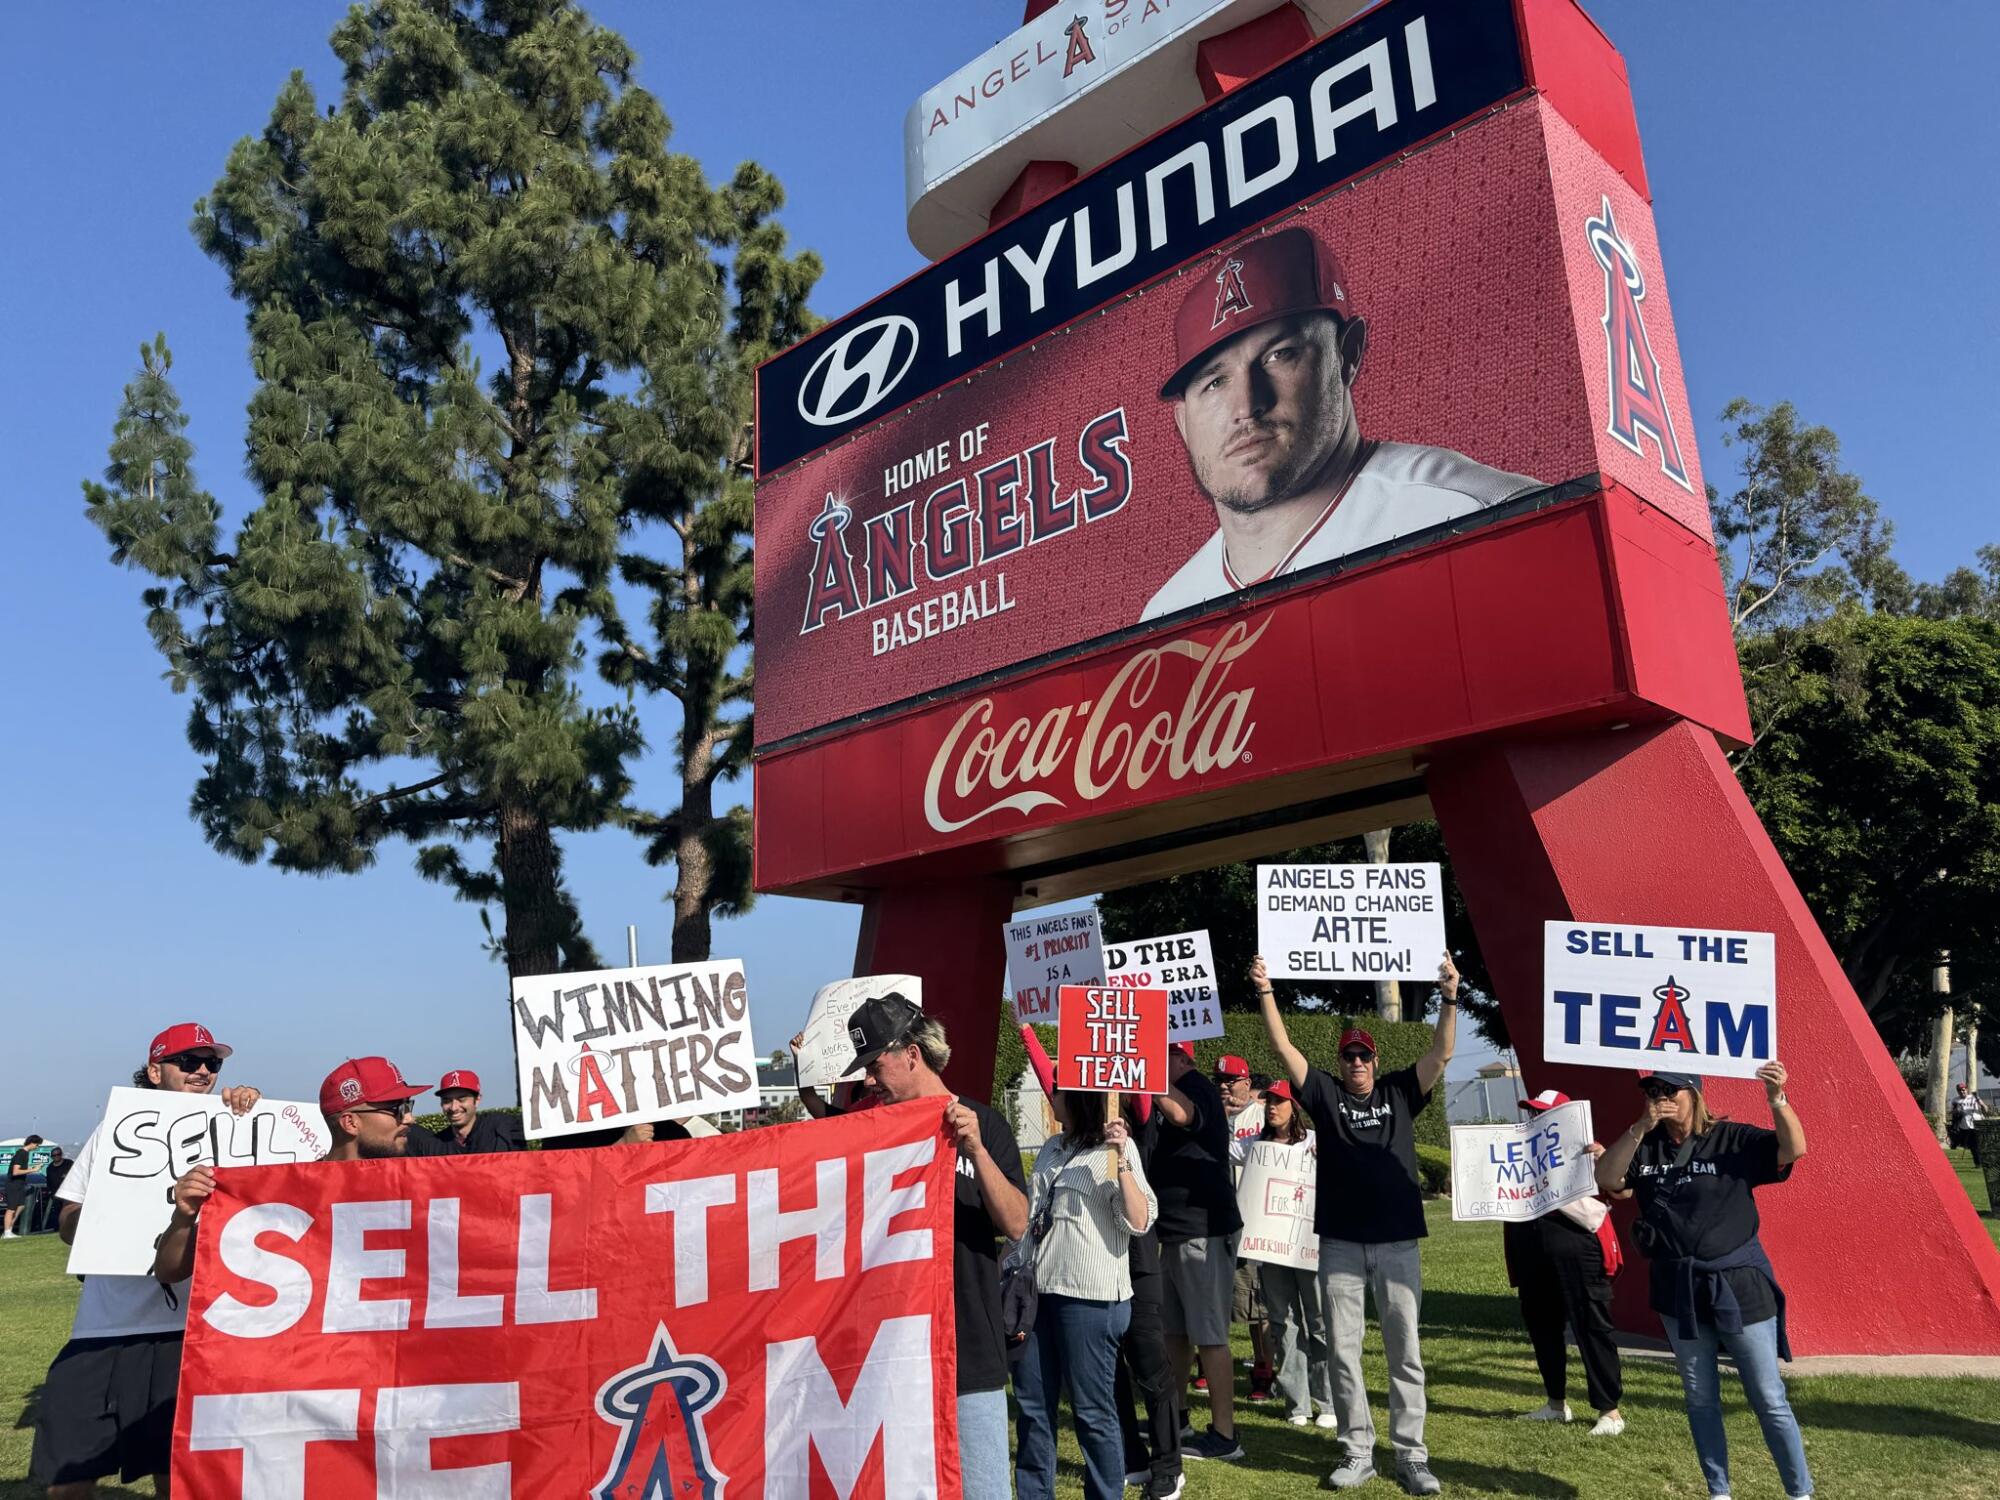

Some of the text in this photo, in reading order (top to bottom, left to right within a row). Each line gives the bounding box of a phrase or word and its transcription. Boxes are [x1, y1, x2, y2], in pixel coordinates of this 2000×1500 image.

[1108, 0, 1170, 35] OF A
[928, 40, 1057, 136] ANGEL
[945, 17, 1436, 357] HYUNDAI
[884, 422, 989, 497] HOME OF
[800, 406, 1133, 635] ANGELS
[872, 573, 1015, 657] BASEBALL
[1267, 869, 1426, 889] ANGELS FANS
[1268, 895, 1434, 912] DEMAND CHANGE
[1010, 914, 1094, 942] THIS ANGELS FAN'S
[1312, 916, 1392, 944] ARTE.
[1025, 932, 1091, 962] #1 PRIORITY
[1103, 938, 1196, 970] D THE
[1288, 949, 1411, 972] SELL NOW!
[1566, 930, 1748, 964] SELL THE
[1046, 964, 1071, 982] IS A
[1161, 964, 1208, 983] ERA
[514, 971, 747, 1049] WINNING
[1017, 985, 1051, 1018] NEW
[1086, 989, 1141, 1021] SELL
[1169, 986, 1211, 1005] RVE
[1554, 975, 1769, 1059] TEAM
[1086, 1022, 1138, 1053] THE
[530, 1031, 752, 1130] MATTERS
[1075, 1054, 1146, 1089] TEAM
[109, 1110, 297, 1180] SELL
[1251, 1145, 1290, 1170] NEW
[1490, 1122, 1560, 1164] LET'S
[1496, 1147, 1565, 1184] MAKE
[1271, 1195, 1289, 1212] FOR
[1470, 1201, 1511, 1216] GREAT
[1525, 1190, 1560, 1211] AGAIN
[1498, 1176, 1549, 1200] ANGELS
[202, 1137, 935, 1338] SELL THE
[1243, 1236, 1292, 1256] OWNERSHIP
[190, 1314, 934, 1500] TEAM
